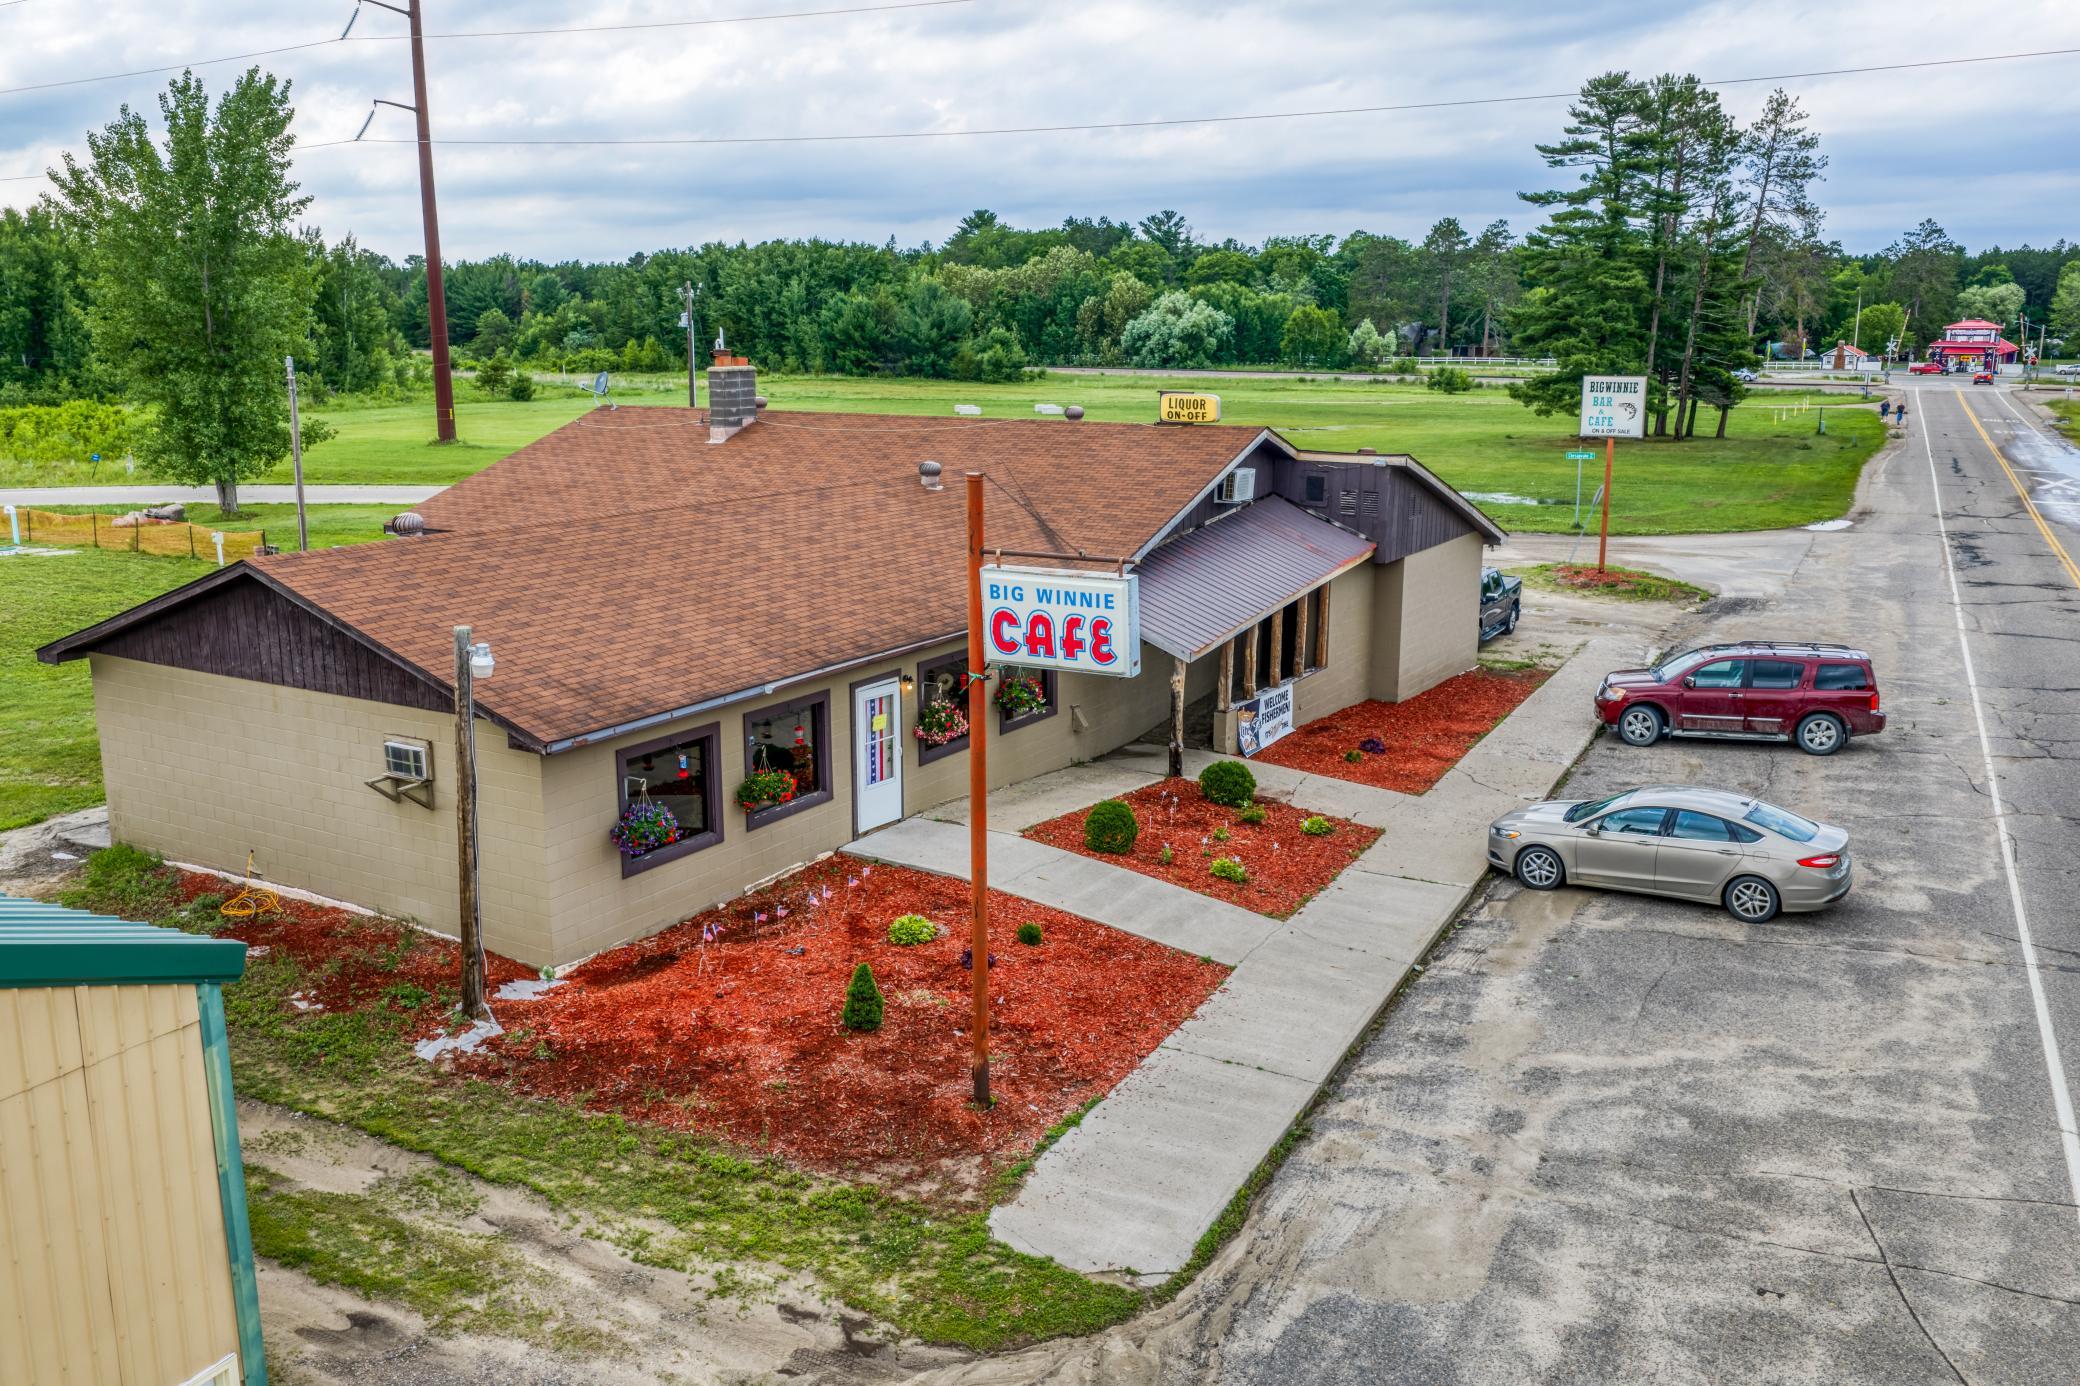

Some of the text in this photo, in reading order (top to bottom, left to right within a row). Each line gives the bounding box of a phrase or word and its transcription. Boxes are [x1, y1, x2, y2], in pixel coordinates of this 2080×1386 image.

[1168, 397, 1206, 411] LIQUOR
[1592, 396, 1613, 407] BAR
[1167, 410, 1207, 421] ON-OFF
[1588, 416, 1613, 427] CAFE
[989, 583, 1115, 610] BIG WINNIE
[990, 606, 1118, 666] CAFE
[1264, 689, 1289, 710] WELCOME
[1261, 700, 1291, 725] FISHERMEN!
